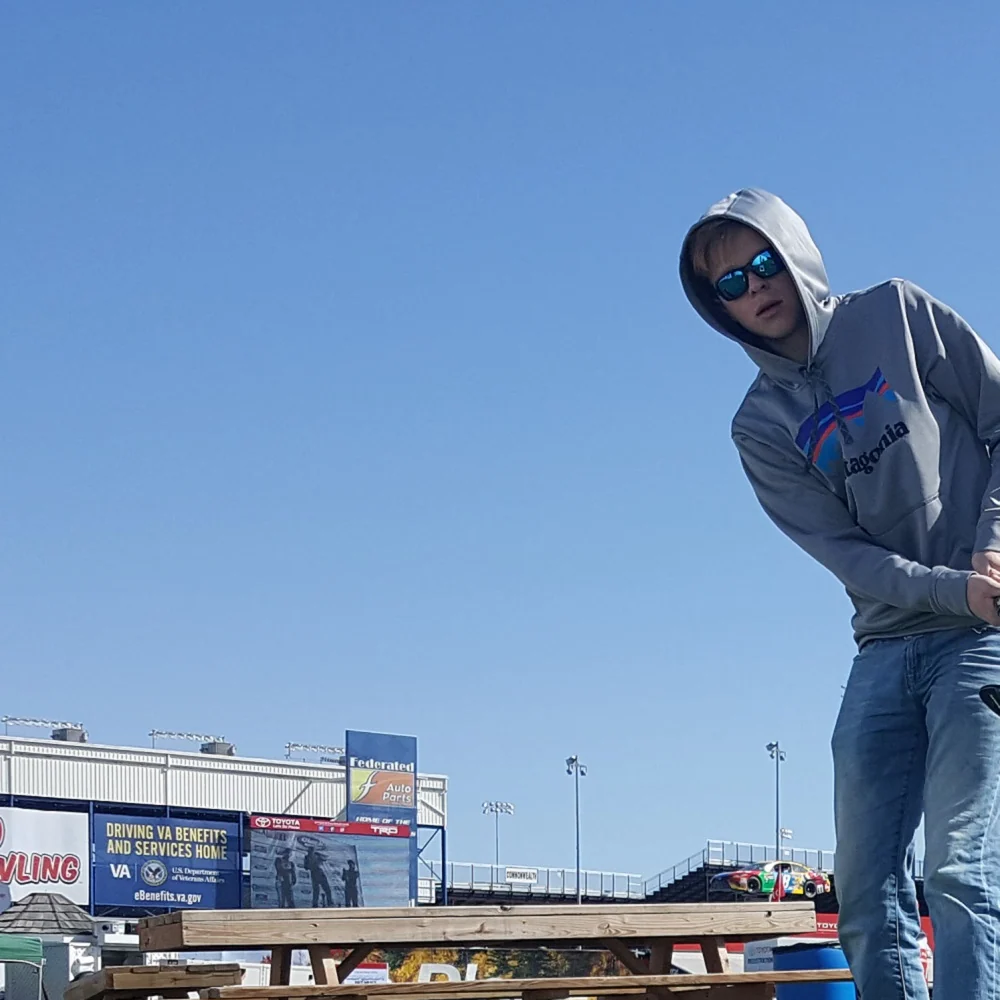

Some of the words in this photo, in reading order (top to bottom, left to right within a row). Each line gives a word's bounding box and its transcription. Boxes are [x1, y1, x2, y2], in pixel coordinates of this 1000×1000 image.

[350, 757, 415, 772] Federated
[386, 783, 411, 793] Auto
[382, 792, 411, 803] Parts
[272, 818, 300, 826] TOYOTA
[355, 816, 380, 824] HOME
[107, 823, 153, 839] DRIVING
[157, 825, 172, 840] VA
[175, 827, 227, 844] BENEFITS
[370, 825, 398, 835] TRD
[107, 839, 131, 855] AND
[135, 841, 192, 858] SERVICES
[195, 844, 227, 860] HOME
[110, 863, 131, 878] VA
[184, 867, 220, 876] Department
[507, 871, 537, 880] COMMONWEALTH
[134, 890, 201, 904] eBenefits.va.gov
